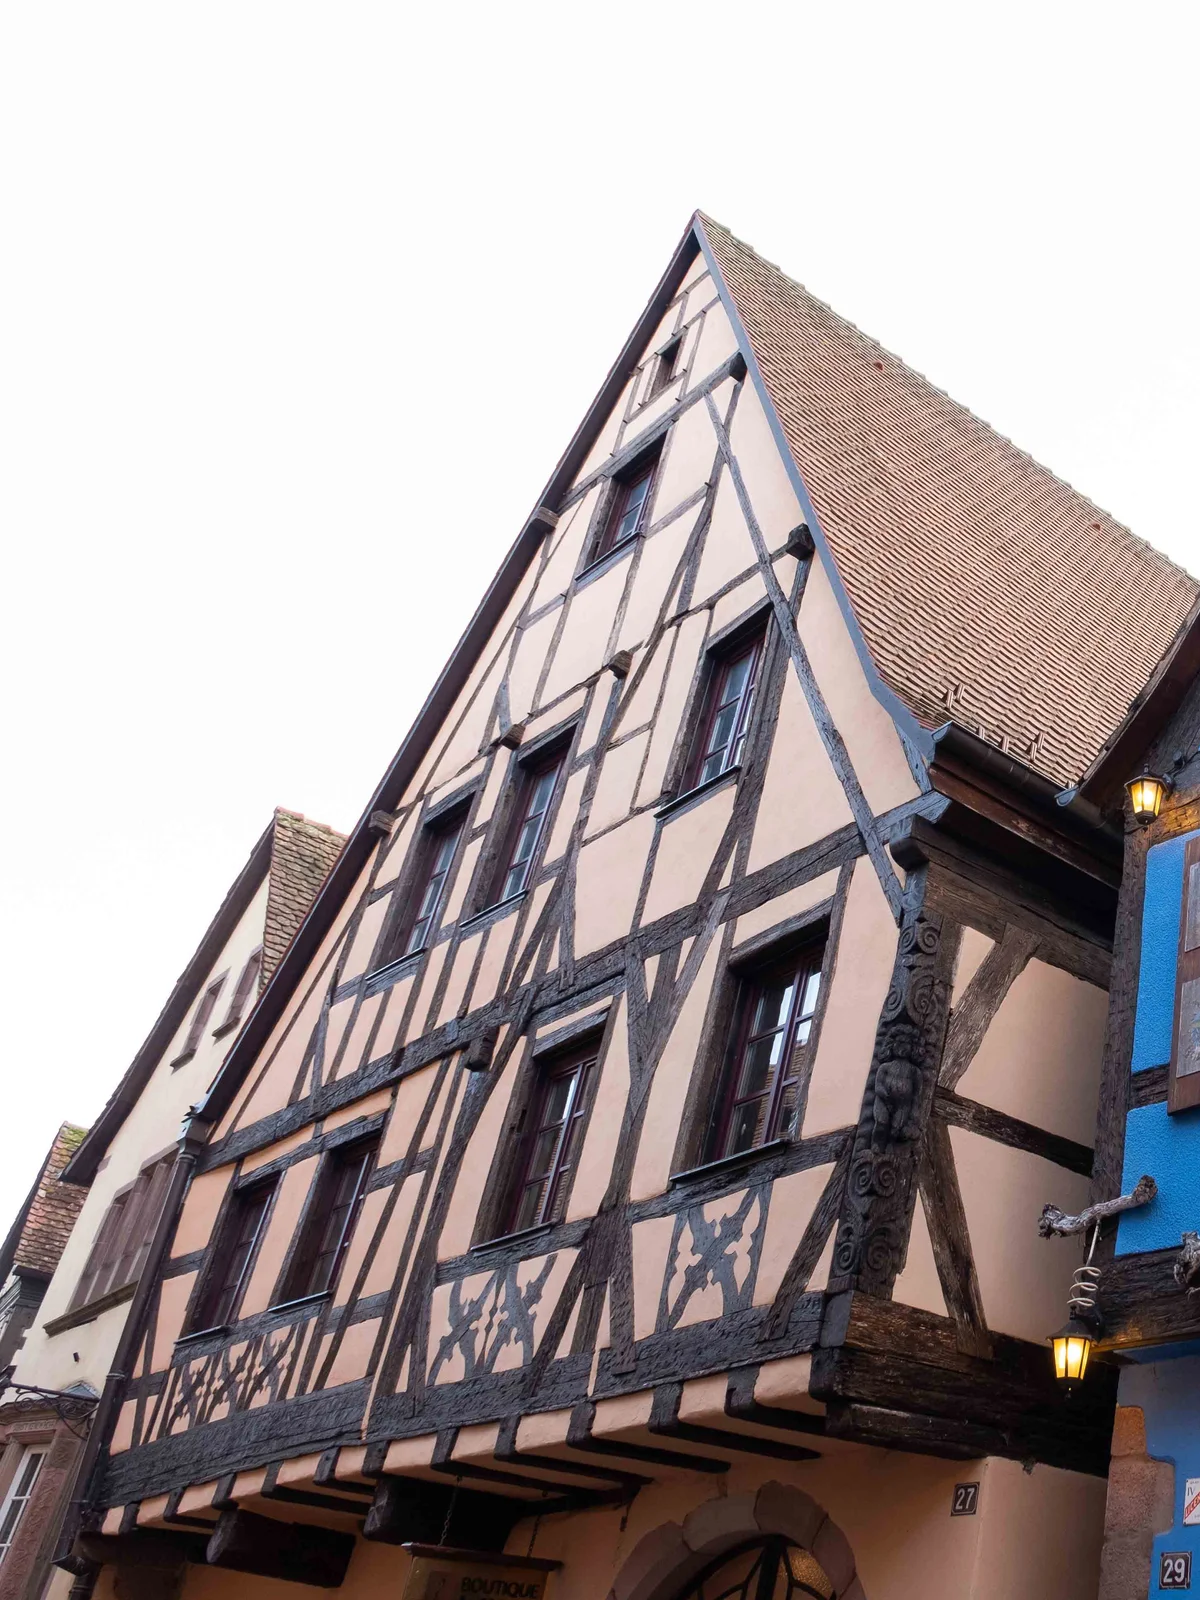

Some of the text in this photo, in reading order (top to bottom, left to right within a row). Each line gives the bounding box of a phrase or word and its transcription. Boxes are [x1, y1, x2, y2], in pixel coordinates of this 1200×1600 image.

[955, 1487, 975, 1510] 27
[1163, 1557, 1185, 1583] 29
[461, 1576, 541, 1599] BOUTIQUE
